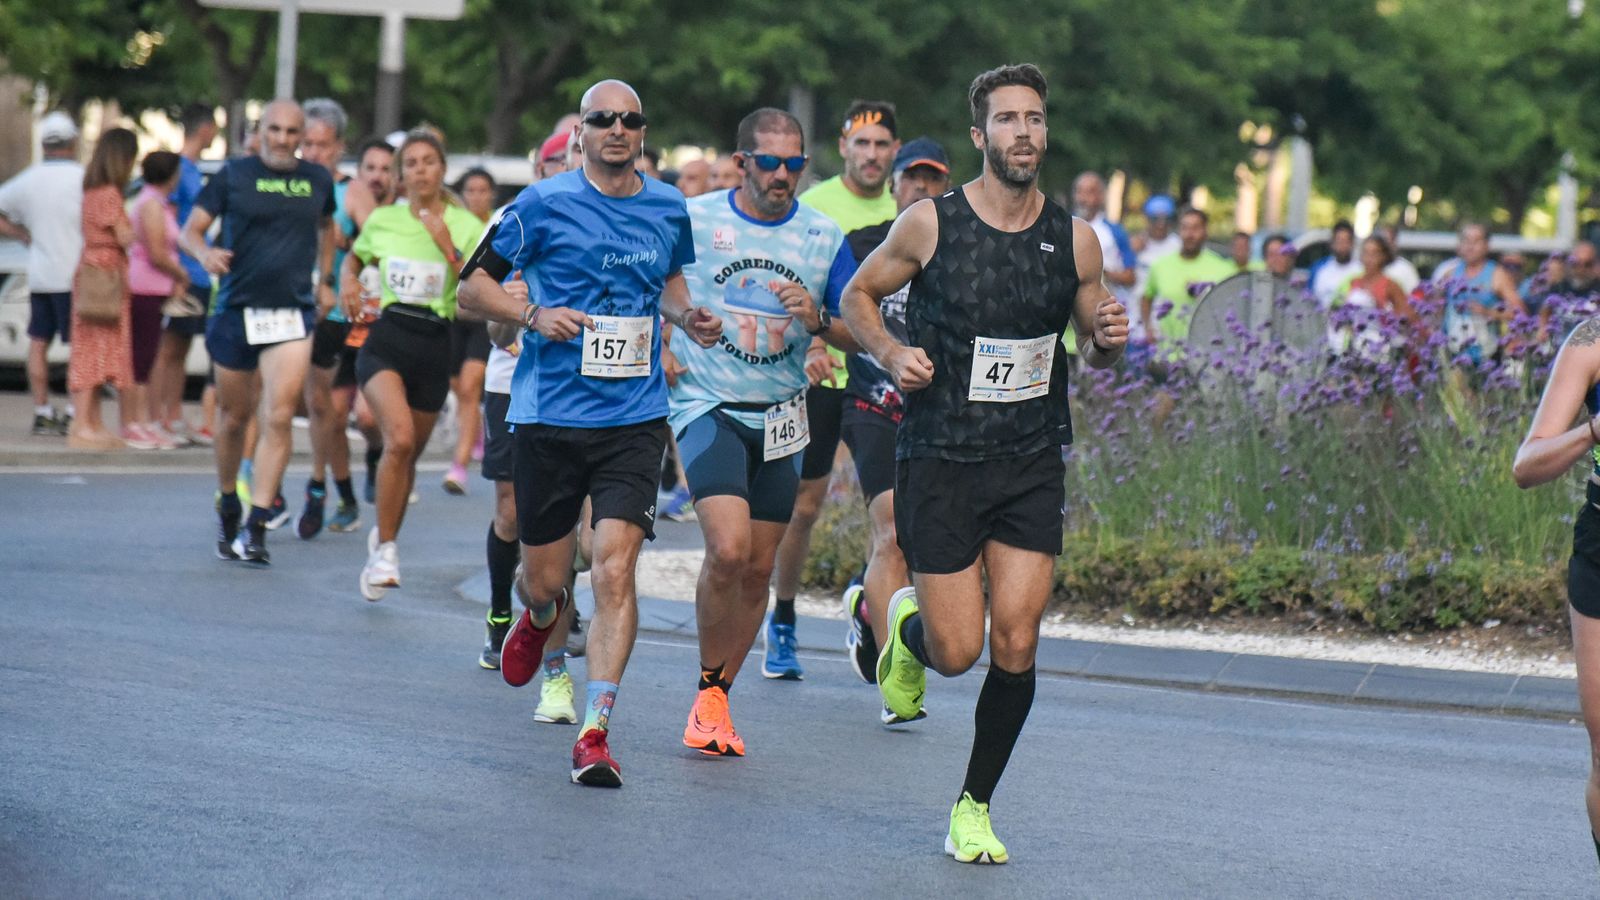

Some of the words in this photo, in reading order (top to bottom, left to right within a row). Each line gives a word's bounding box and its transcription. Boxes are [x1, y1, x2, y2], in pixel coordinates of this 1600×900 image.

[601, 249, 659, 270] Running
[714, 258, 808, 291] CORREDORE
[591, 337, 627, 361] 157
[979, 343, 995, 354] XXI
[985, 361, 1015, 385] 47
[770, 418, 796, 445] 146
